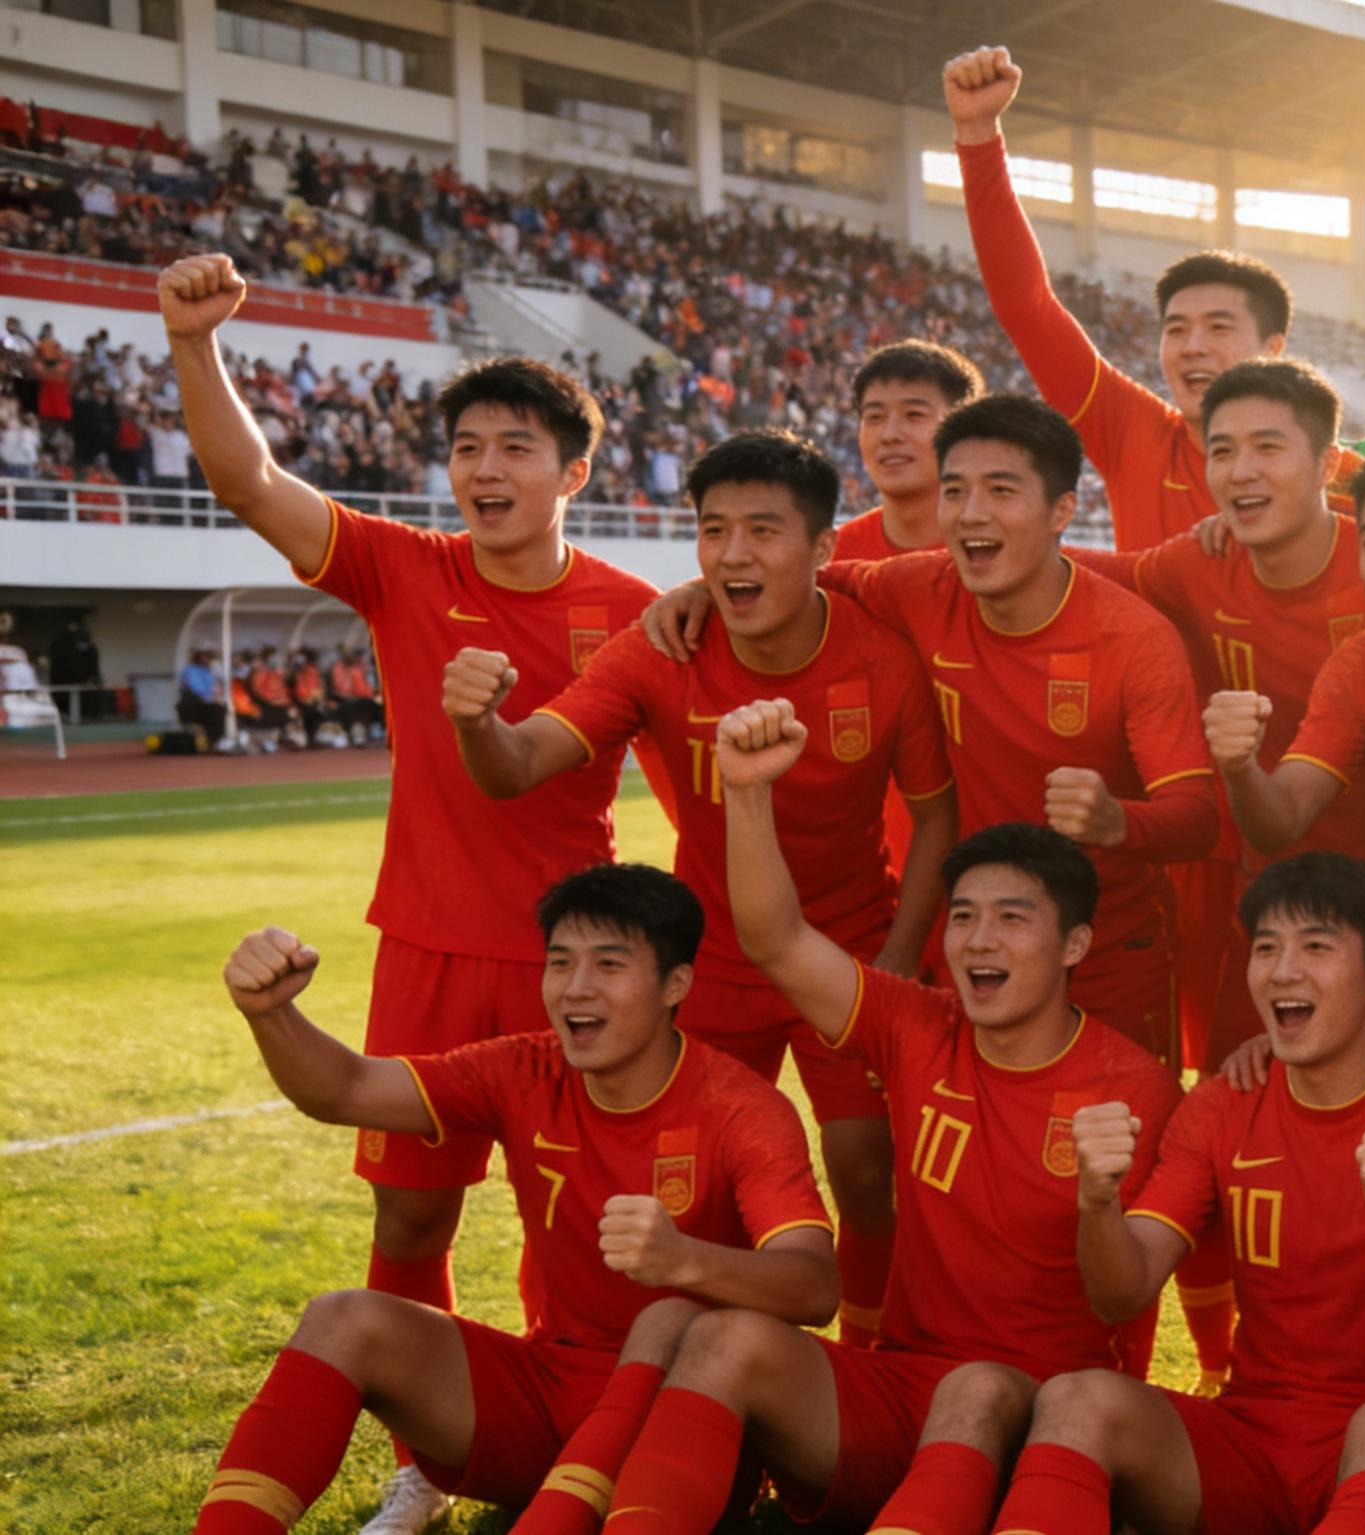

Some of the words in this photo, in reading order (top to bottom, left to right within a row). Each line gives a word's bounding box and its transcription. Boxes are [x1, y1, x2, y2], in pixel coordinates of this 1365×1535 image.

[911, 1104, 973, 1194] 10
[534, 1163, 564, 1230] 7
[1227, 1185, 1283, 1269] 10
